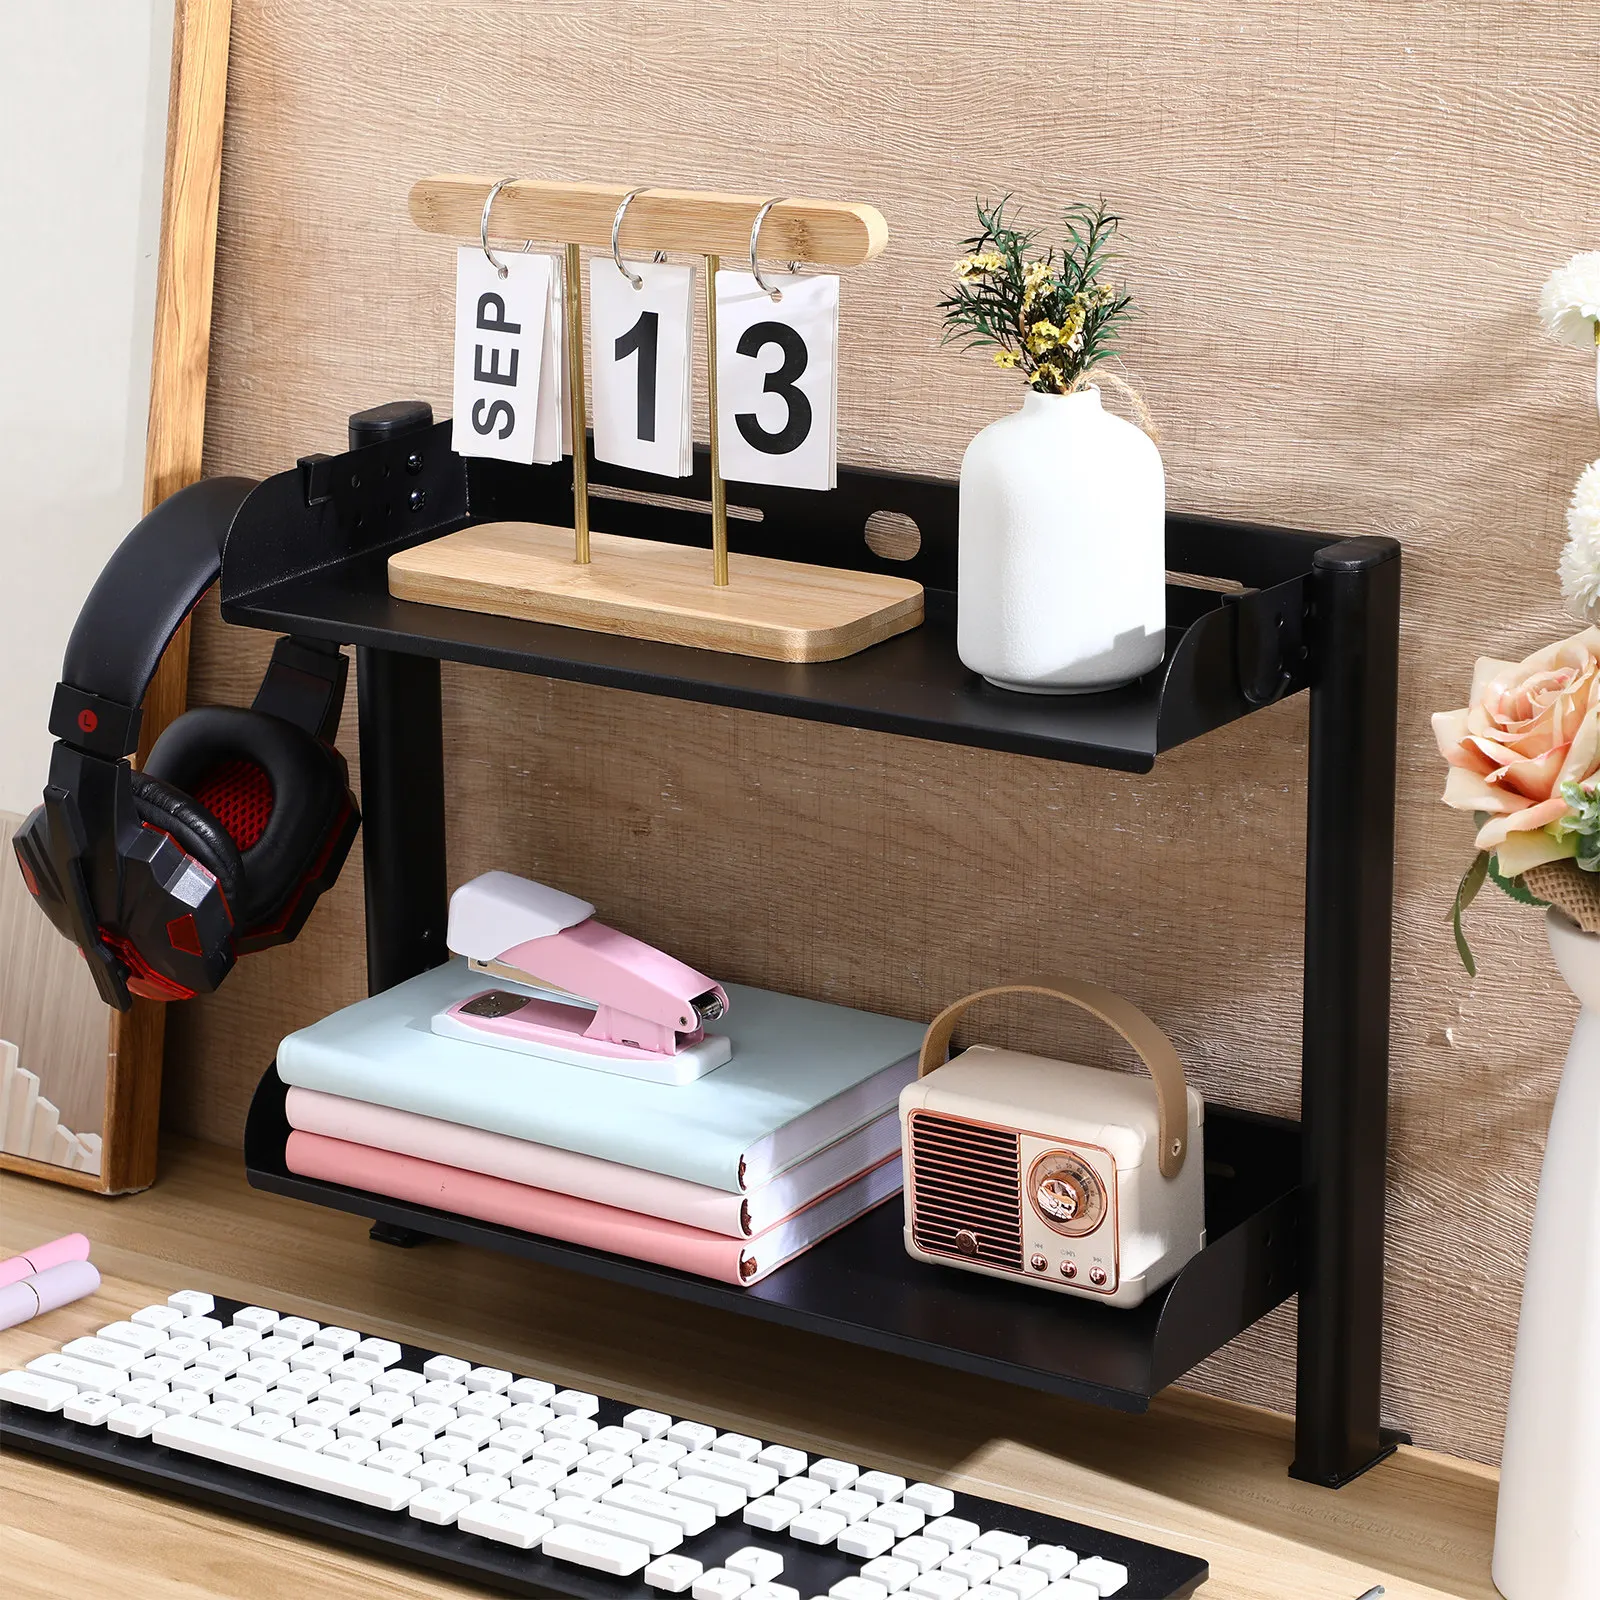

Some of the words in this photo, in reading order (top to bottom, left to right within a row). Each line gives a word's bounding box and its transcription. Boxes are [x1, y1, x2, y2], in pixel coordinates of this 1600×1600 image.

[472, 291, 521, 440] SEP
[614, 310, 659, 443] 1
[734, 321, 812, 455] 3
[83, 714, 92, 727] L
